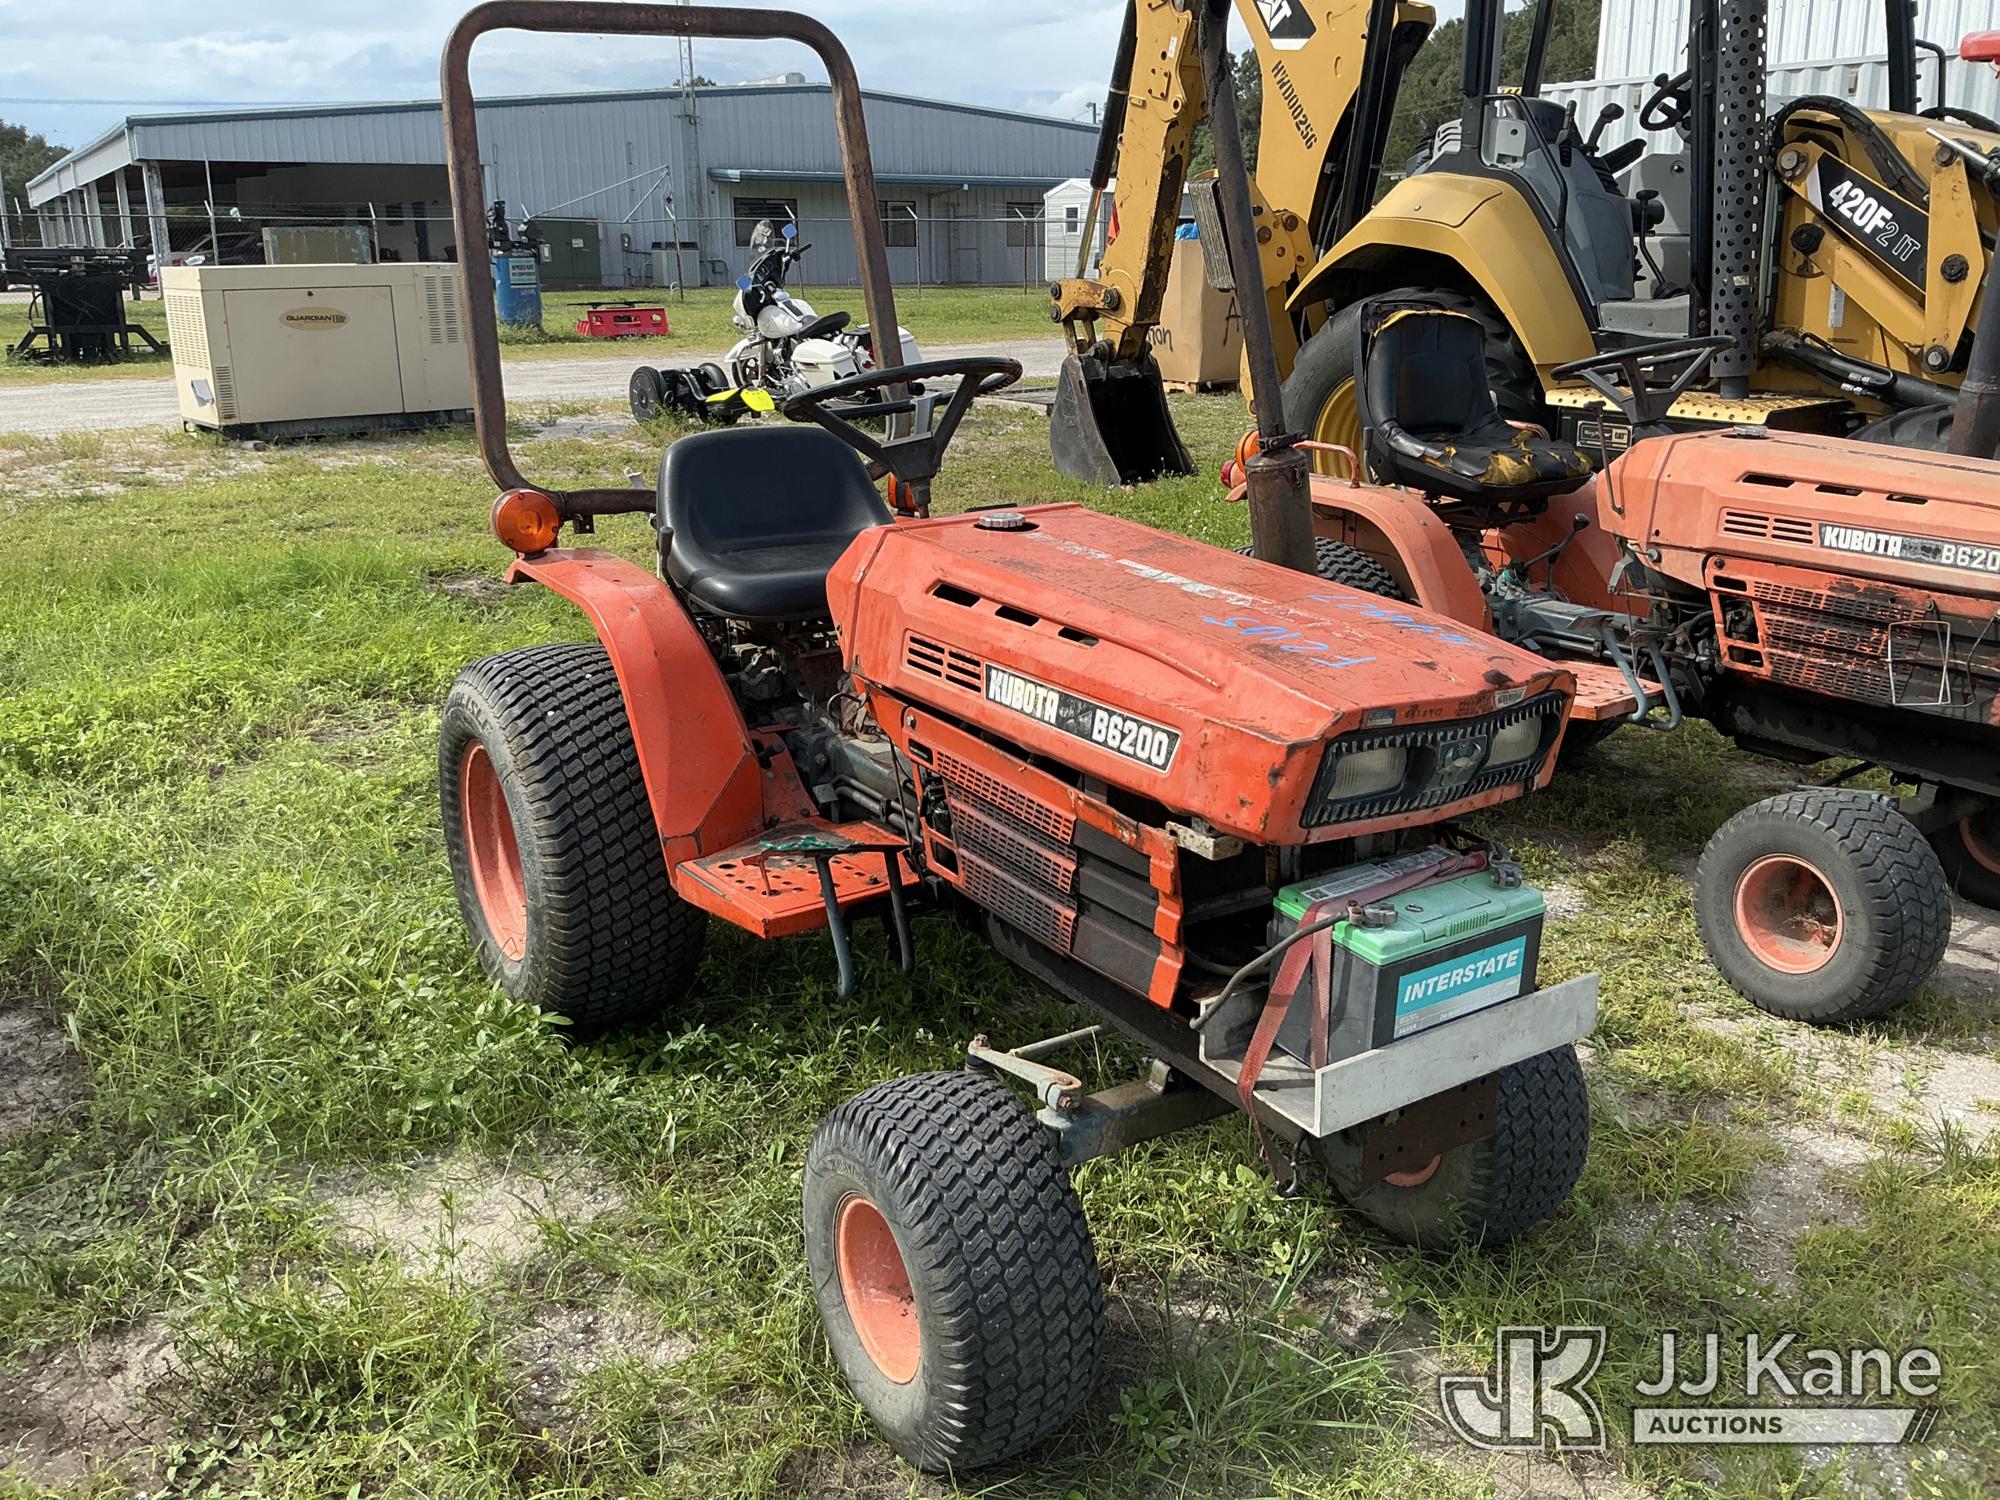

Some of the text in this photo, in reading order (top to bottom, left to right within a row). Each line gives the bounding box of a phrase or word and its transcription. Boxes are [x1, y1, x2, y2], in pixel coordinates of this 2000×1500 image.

[1892, 234, 1922, 262] IT
[286, 314, 332, 322] GUARDIAN
[1823, 526, 1903, 557] KUBOTA
[988, 668, 1060, 724] KUBOTA
[1091, 708, 1169, 766] B6200
[1403, 948, 1520, 1005] INTERSTATE
